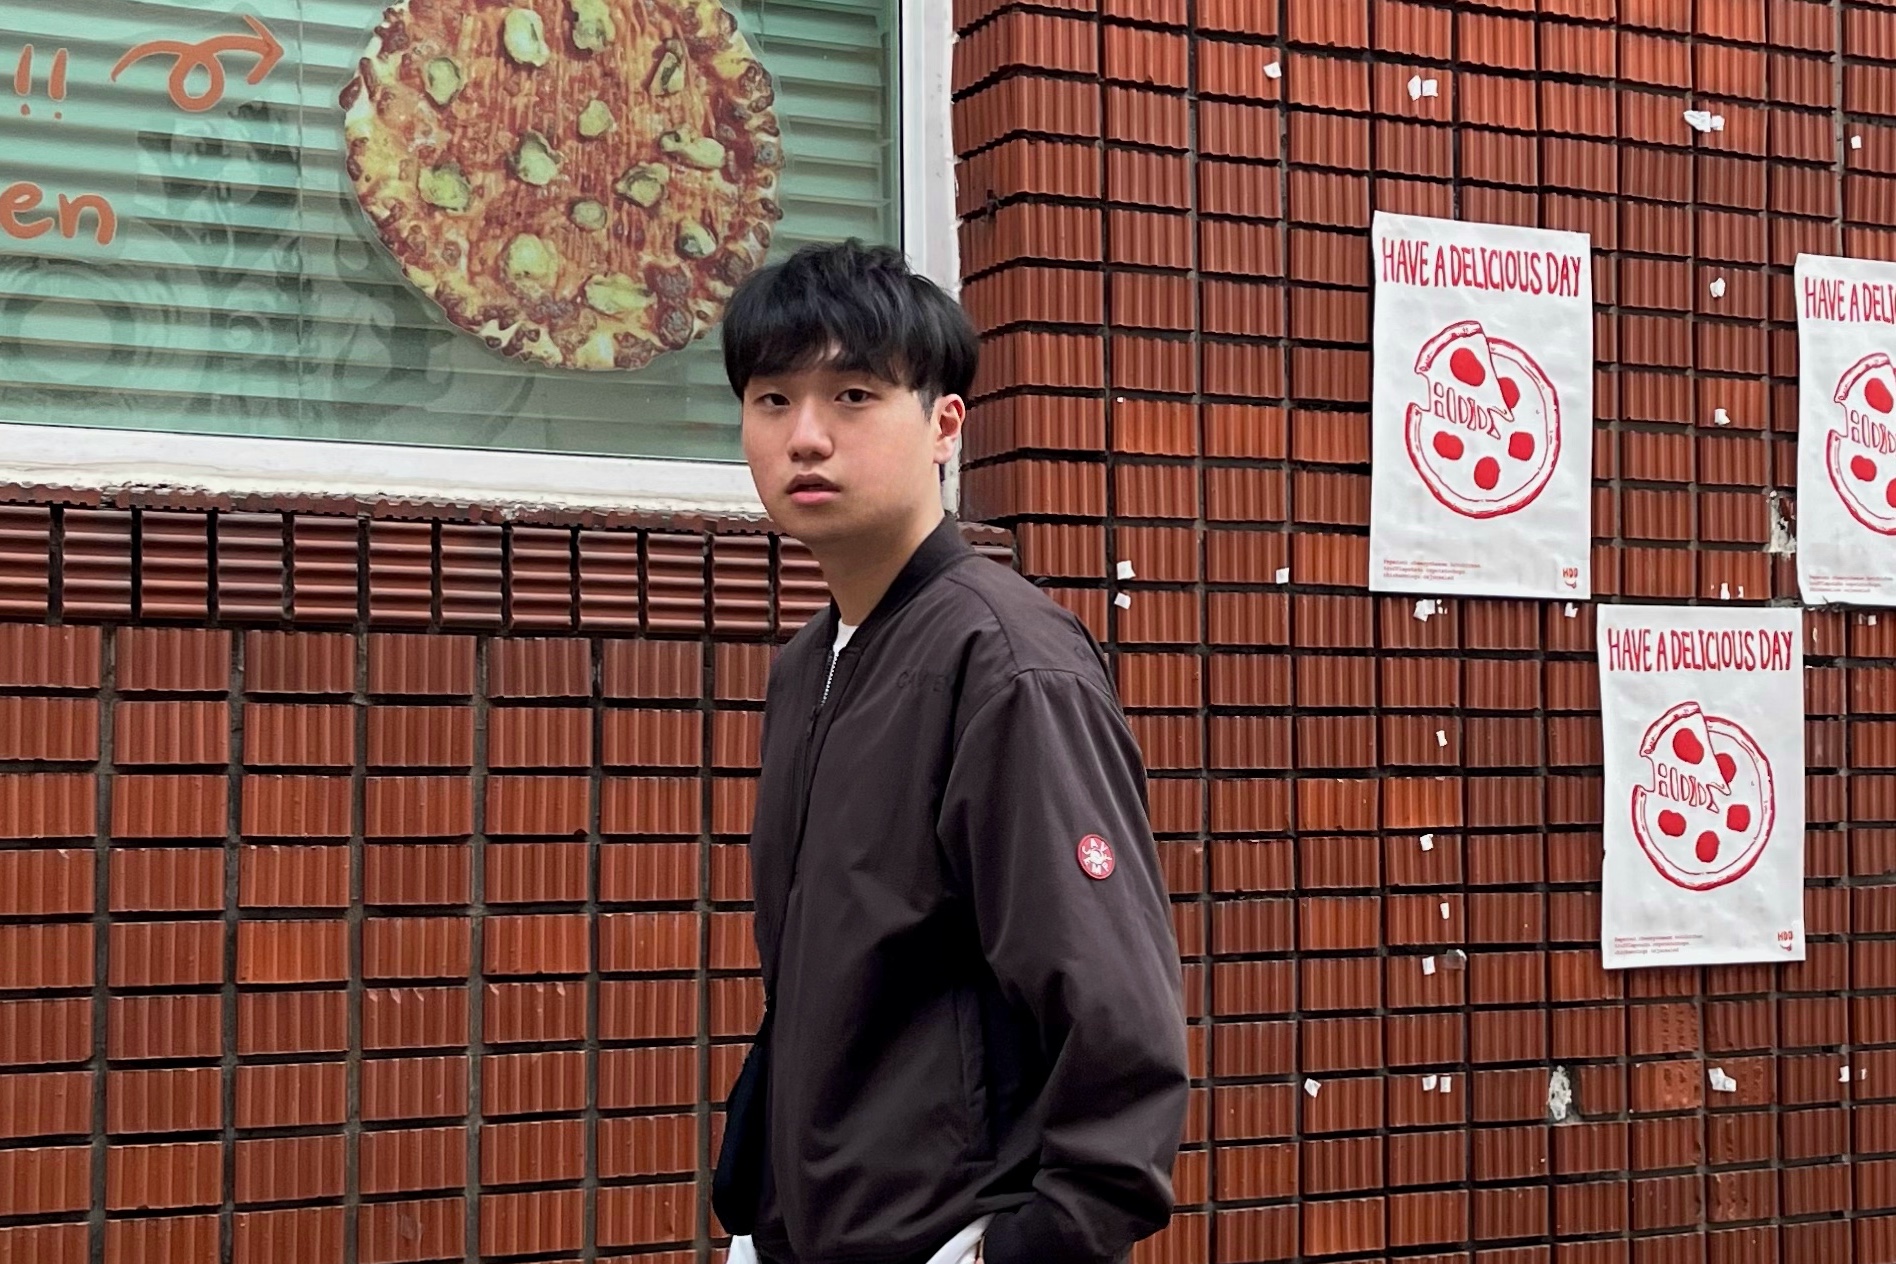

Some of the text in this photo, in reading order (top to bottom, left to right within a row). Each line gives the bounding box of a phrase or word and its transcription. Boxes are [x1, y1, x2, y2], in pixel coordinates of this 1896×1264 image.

[1382, 237, 1581, 297] HAVE A DELICIOUS DAY
[1804, 276, 1896, 325] HAVE A DELI
[1608, 628, 1793, 672] HAVE A DELICIOUS DAY
